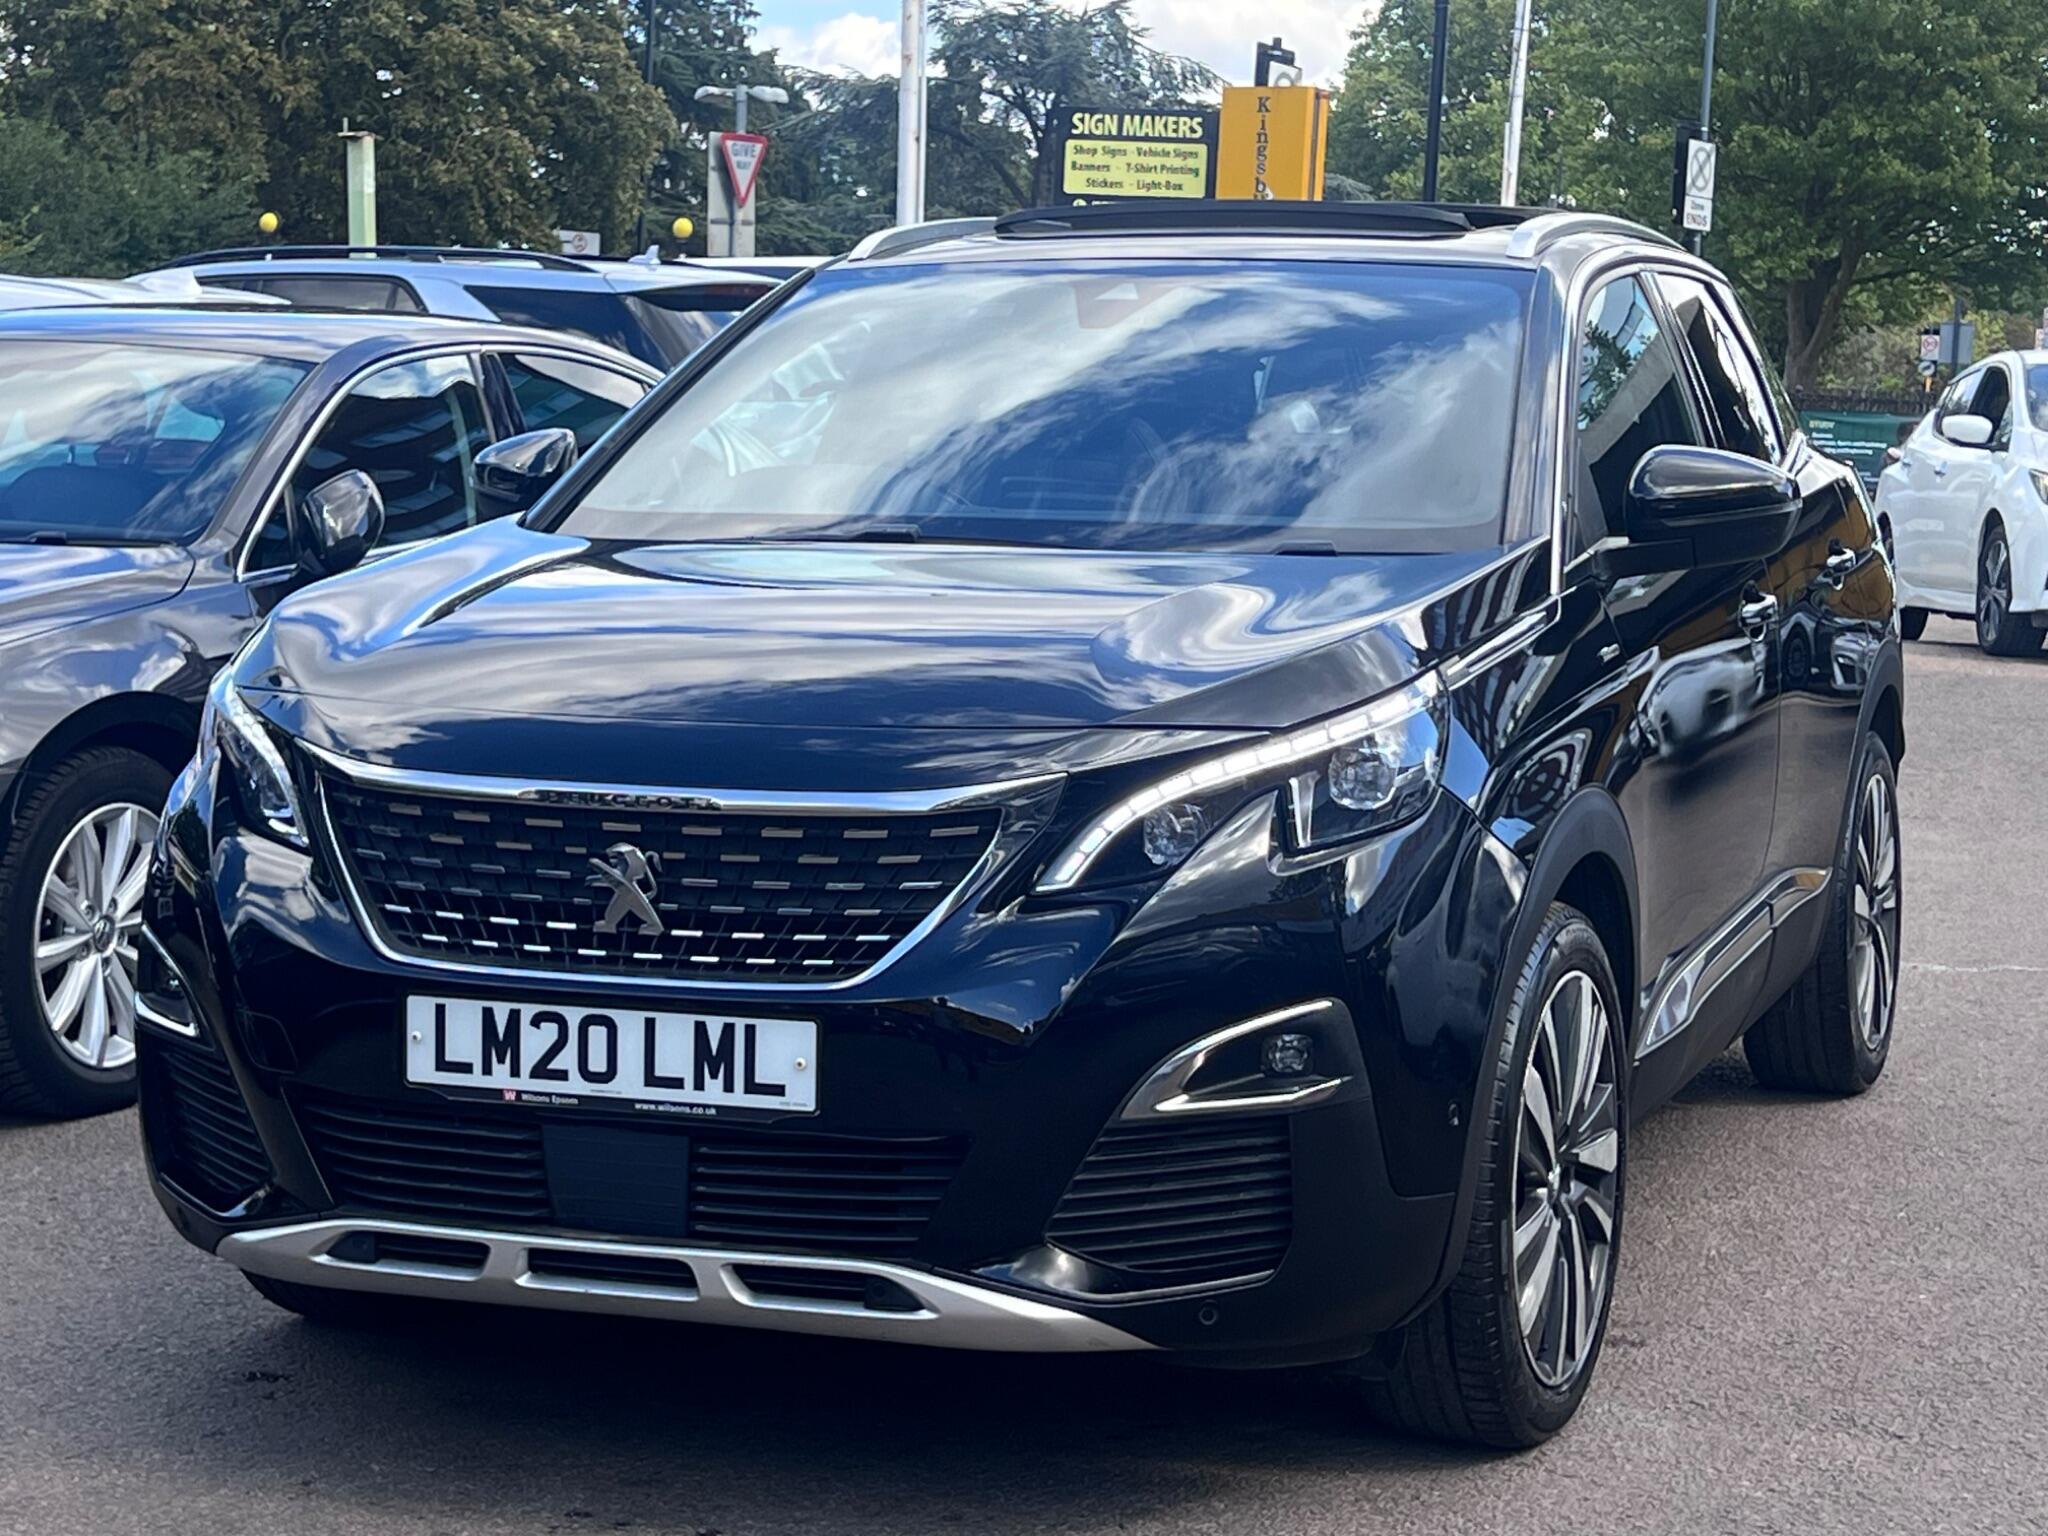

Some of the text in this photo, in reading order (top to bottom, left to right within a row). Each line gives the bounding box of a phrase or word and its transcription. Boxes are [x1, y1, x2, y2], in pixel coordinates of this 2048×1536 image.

[1071, 112, 1203, 138] SIGN MAKERS
[731, 142, 756, 158] GIVE
[1073, 145, 1199, 160] Shop Signs Vehicle Signs
[1071, 161, 1199, 177] Banners T-Shirt Printing
[1086, 178, 1184, 192] Stickers Light-Box
[434, 1002, 787, 1097] LM20 LML
[551, 1095, 579, 1105] Epsom
[634, 1103, 717, 1115] www.wilsons.co.uk
